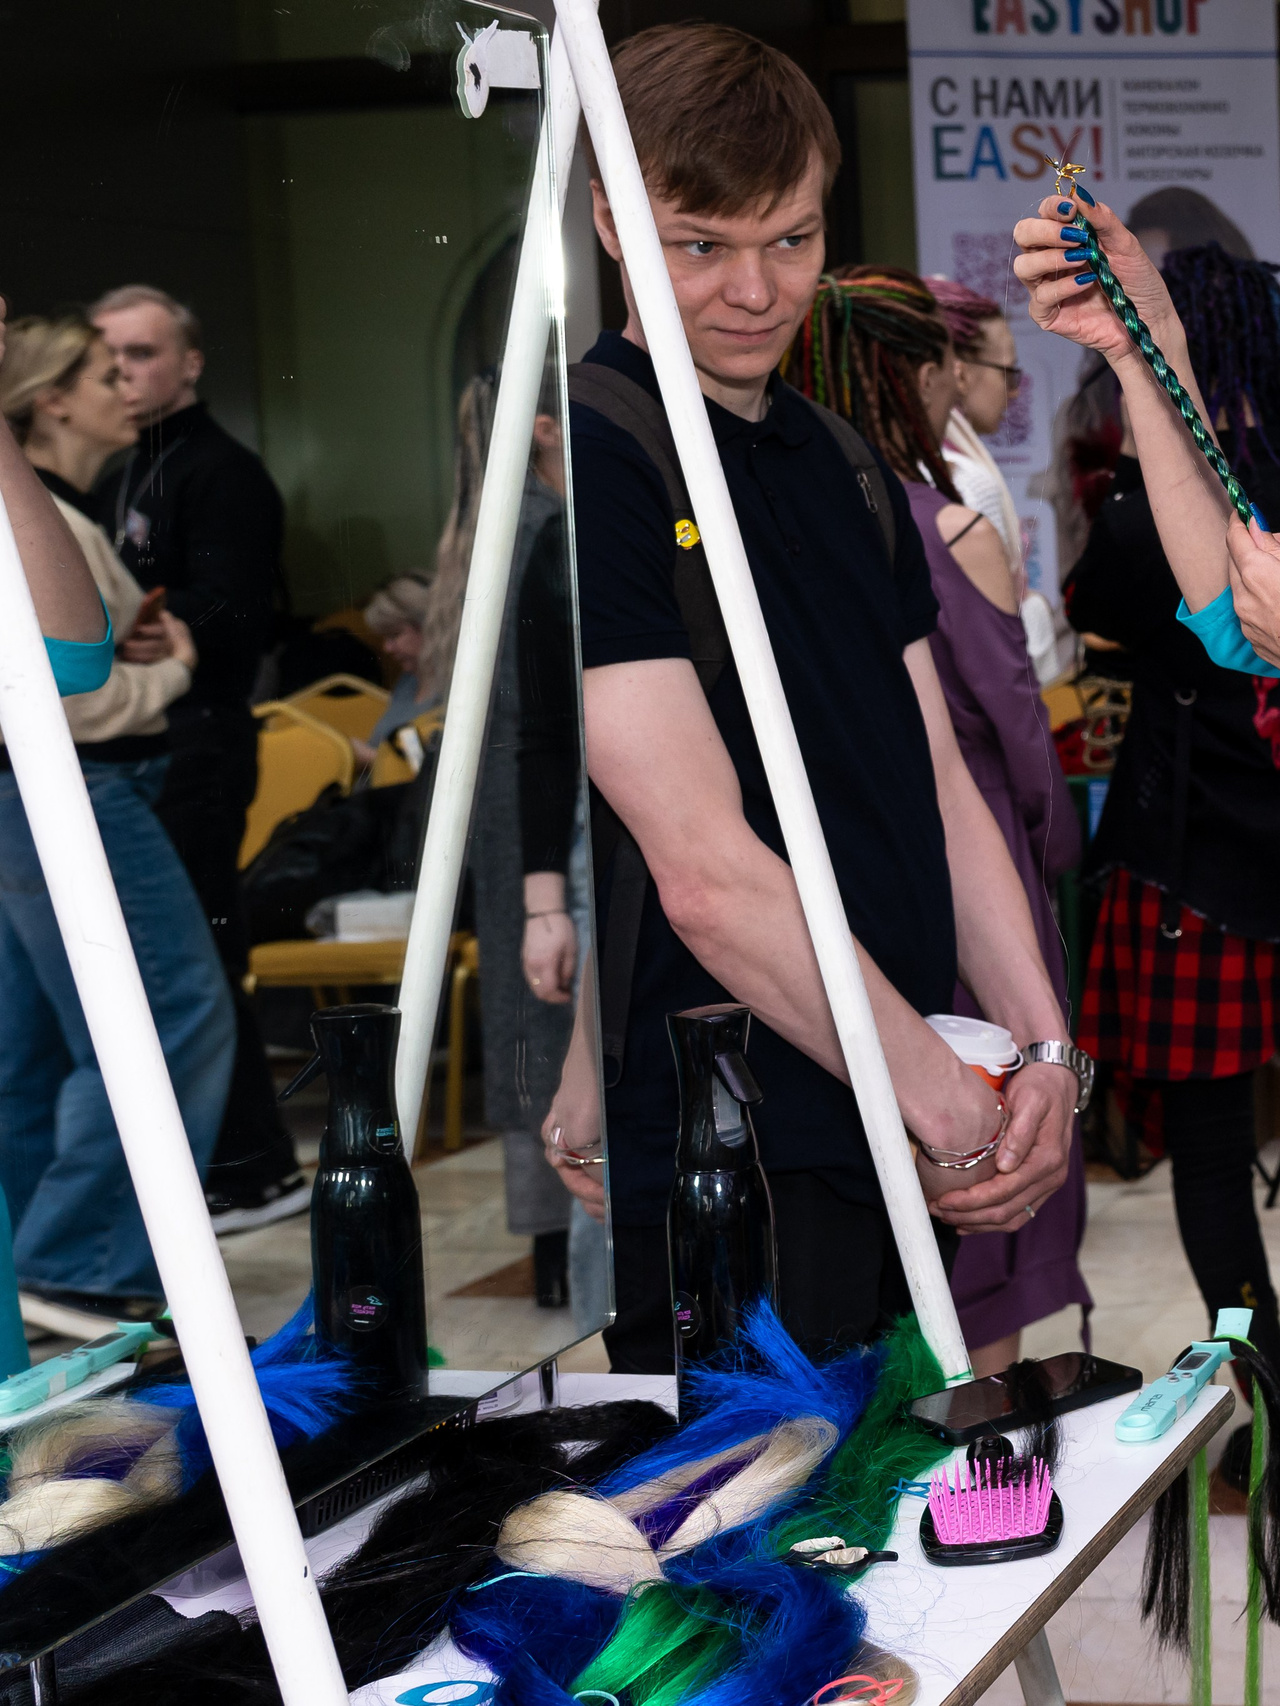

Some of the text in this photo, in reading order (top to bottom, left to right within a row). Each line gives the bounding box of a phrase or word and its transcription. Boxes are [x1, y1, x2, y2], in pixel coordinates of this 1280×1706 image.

[930, 77, 1101, 119] С НАМИ
[932, 123, 1105, 182] EASY!
